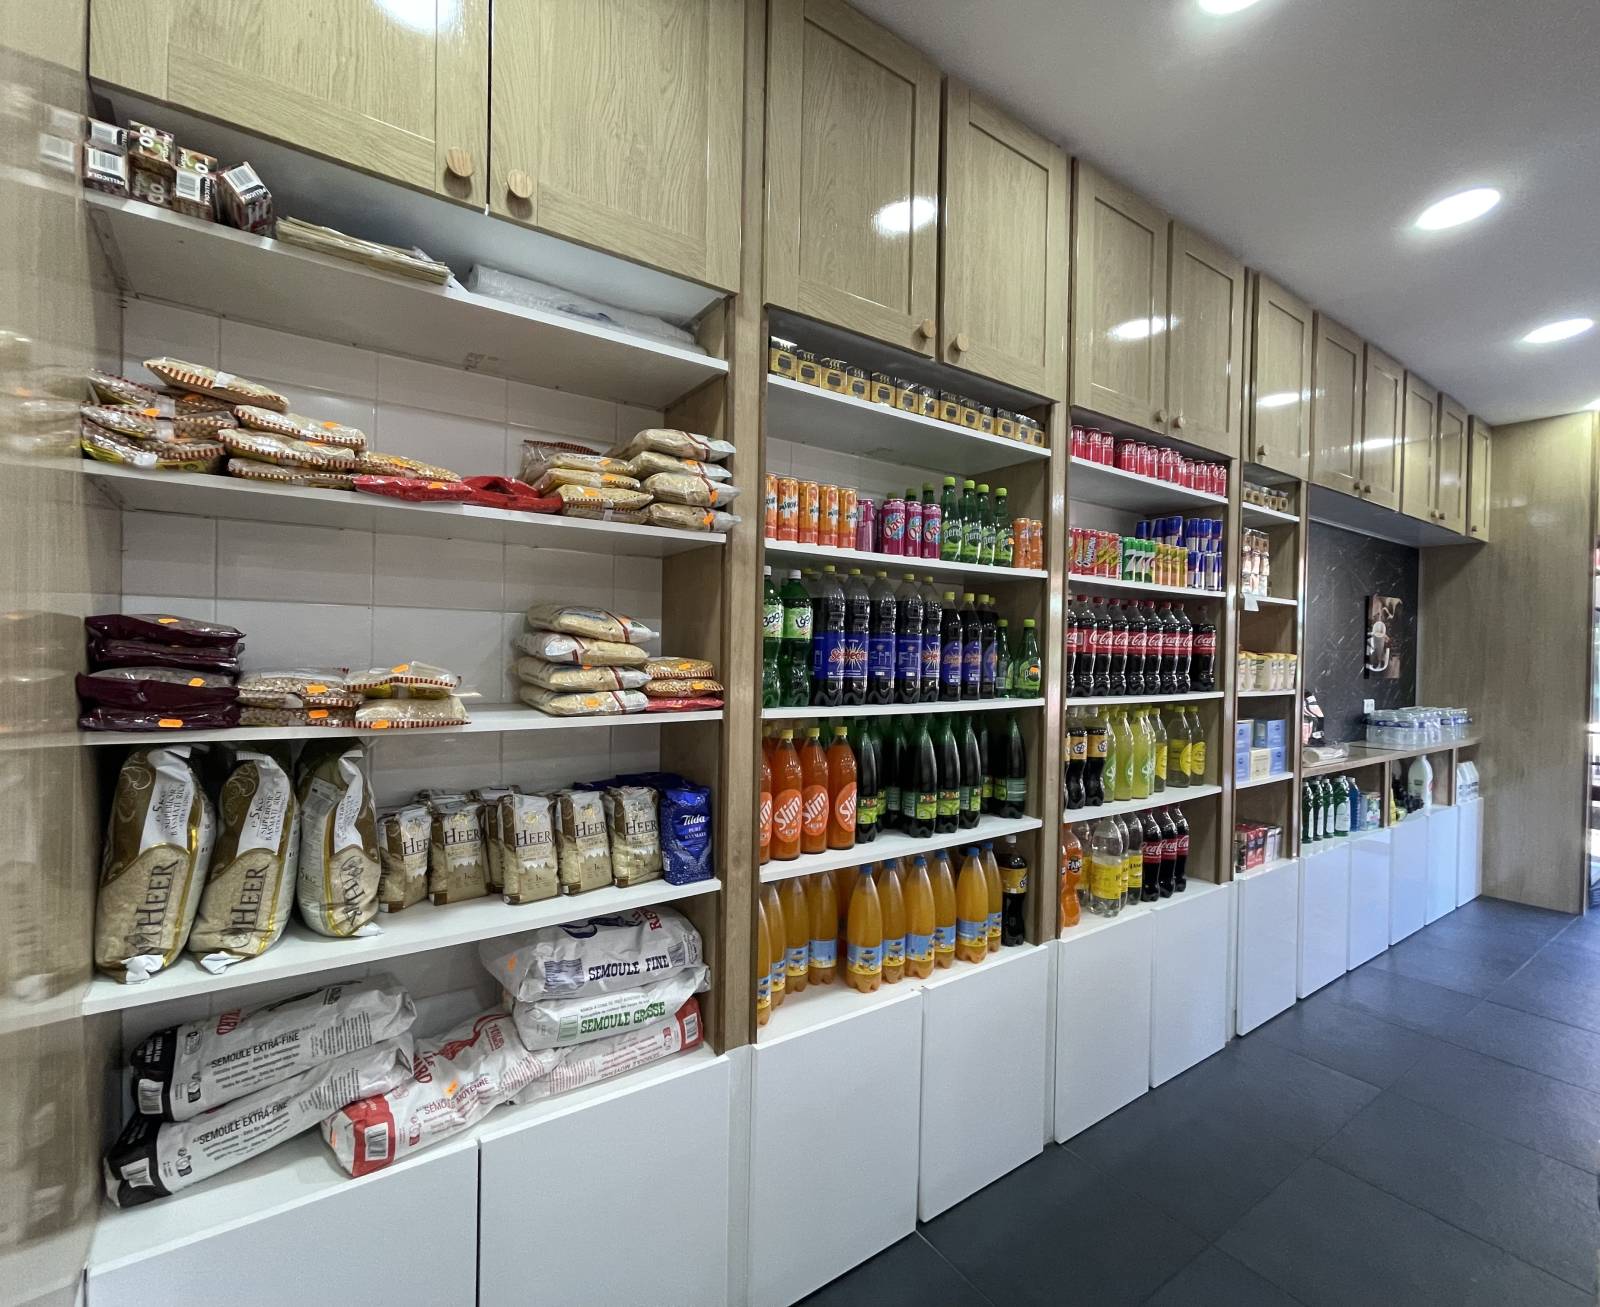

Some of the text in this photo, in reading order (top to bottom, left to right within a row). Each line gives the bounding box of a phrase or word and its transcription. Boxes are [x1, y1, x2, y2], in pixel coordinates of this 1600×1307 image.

[681, 814, 706, 826] Tilda
[774, 796, 801, 832] Slim
[444, 828, 480, 844] HEER
[516, 830, 552, 846] HEER
[576, 822, 607, 837] HEER
[626, 820, 657, 835] HEER
[403, 838, 428, 855] HEE
[135, 860, 179, 926] HEER
[230, 864, 270, 926] HEER
[588, 955, 670, 981] SEMOULE FINE
[580, 1012, 630, 1033] SEMOULE
[211, 1032, 300, 1069] SEMOULE EXTRA-FINE
[199, 1120, 240, 1145] SEMOULE
[243, 1102, 288, 1127] EXTRA-FINE
